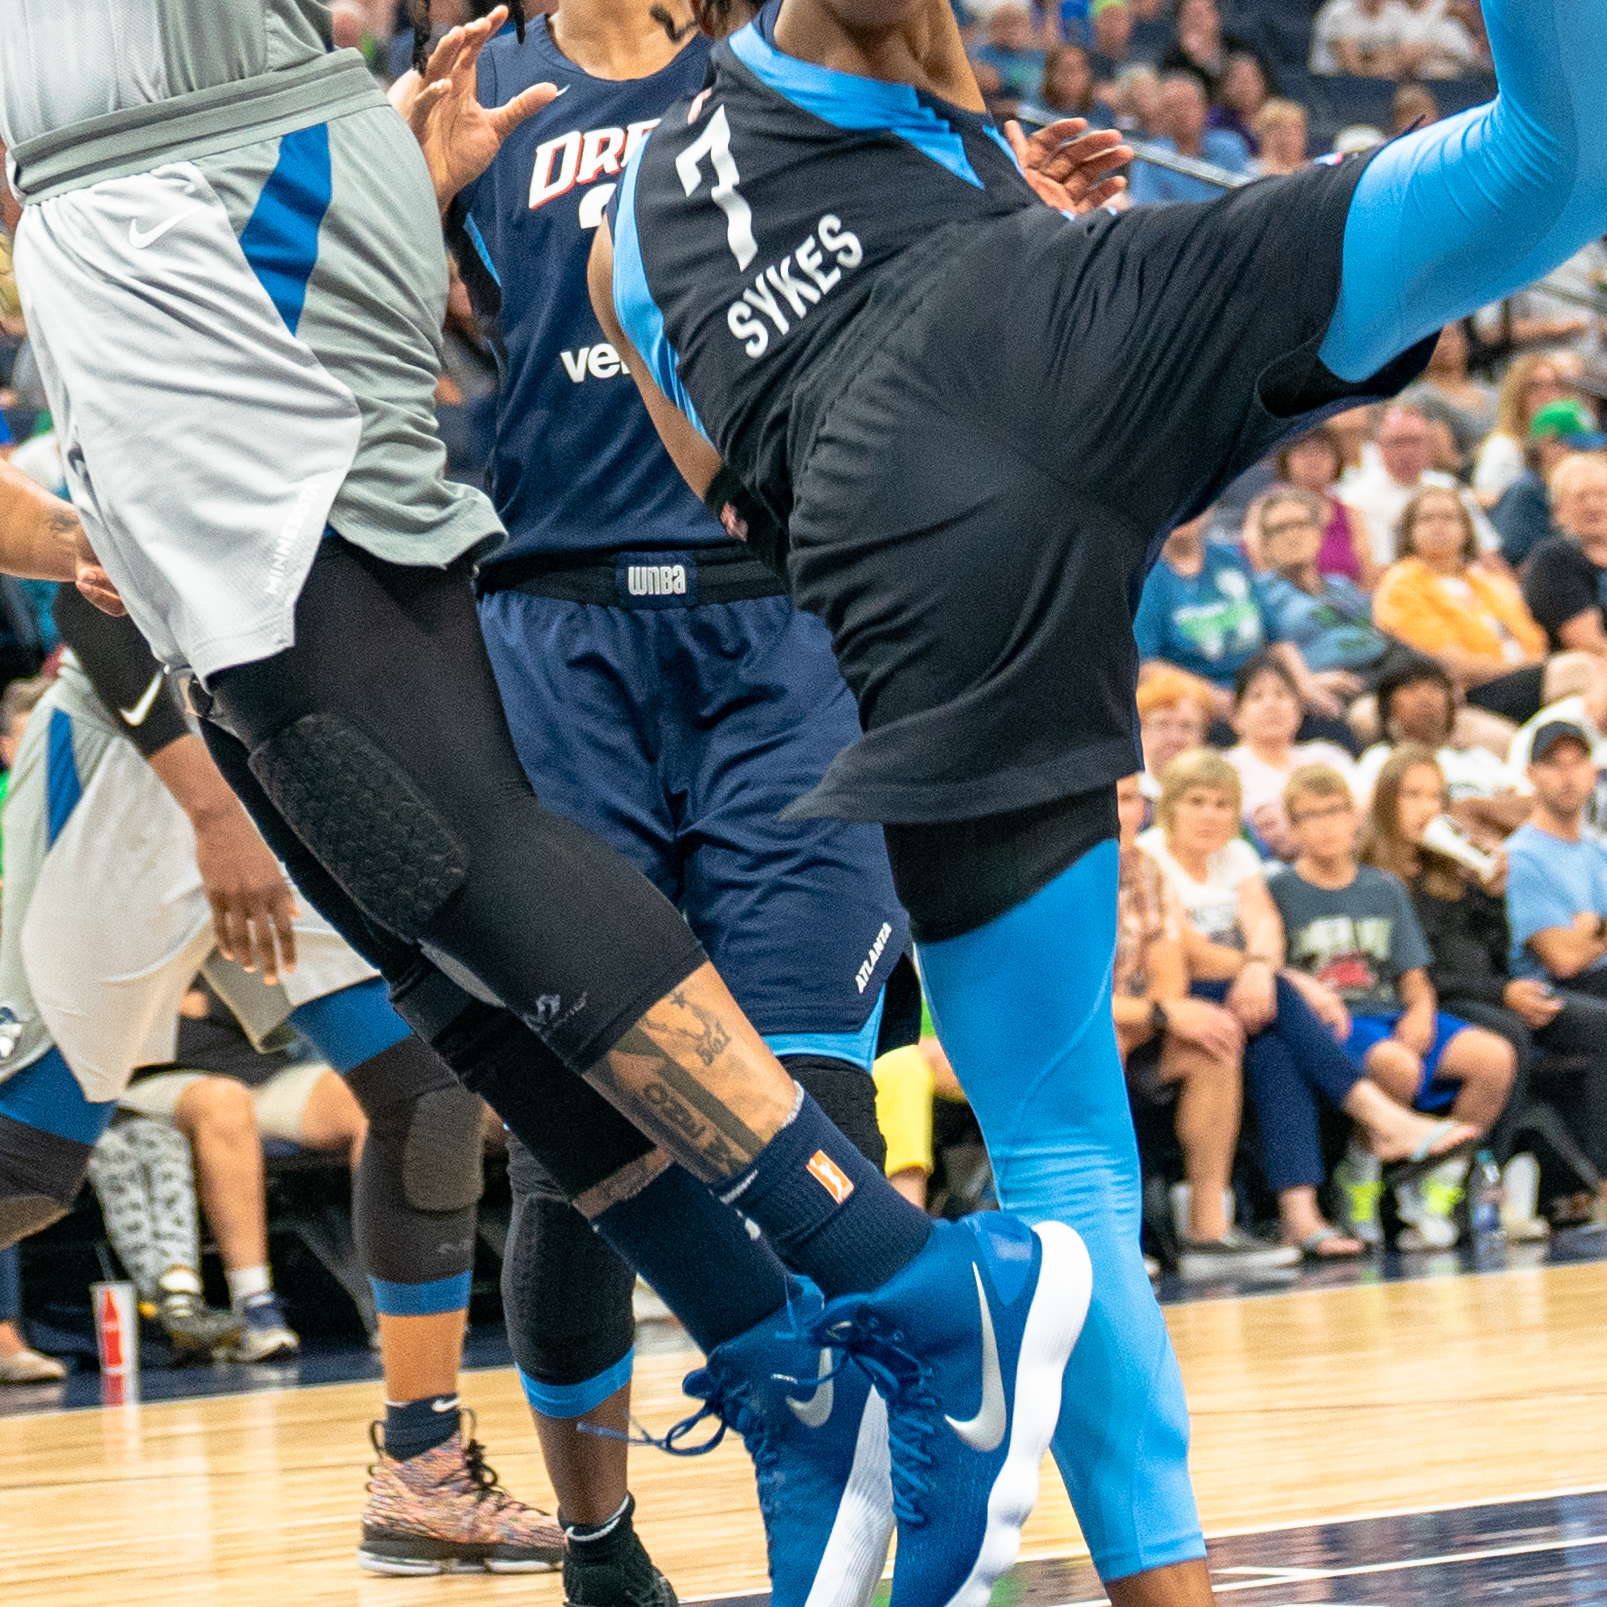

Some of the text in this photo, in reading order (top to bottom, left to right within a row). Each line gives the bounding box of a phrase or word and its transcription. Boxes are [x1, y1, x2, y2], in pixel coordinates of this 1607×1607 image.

[675, 103, 758, 272] 7
[727, 214, 863, 359] SYKES
[855, 921, 893, 994] ATLANTA
